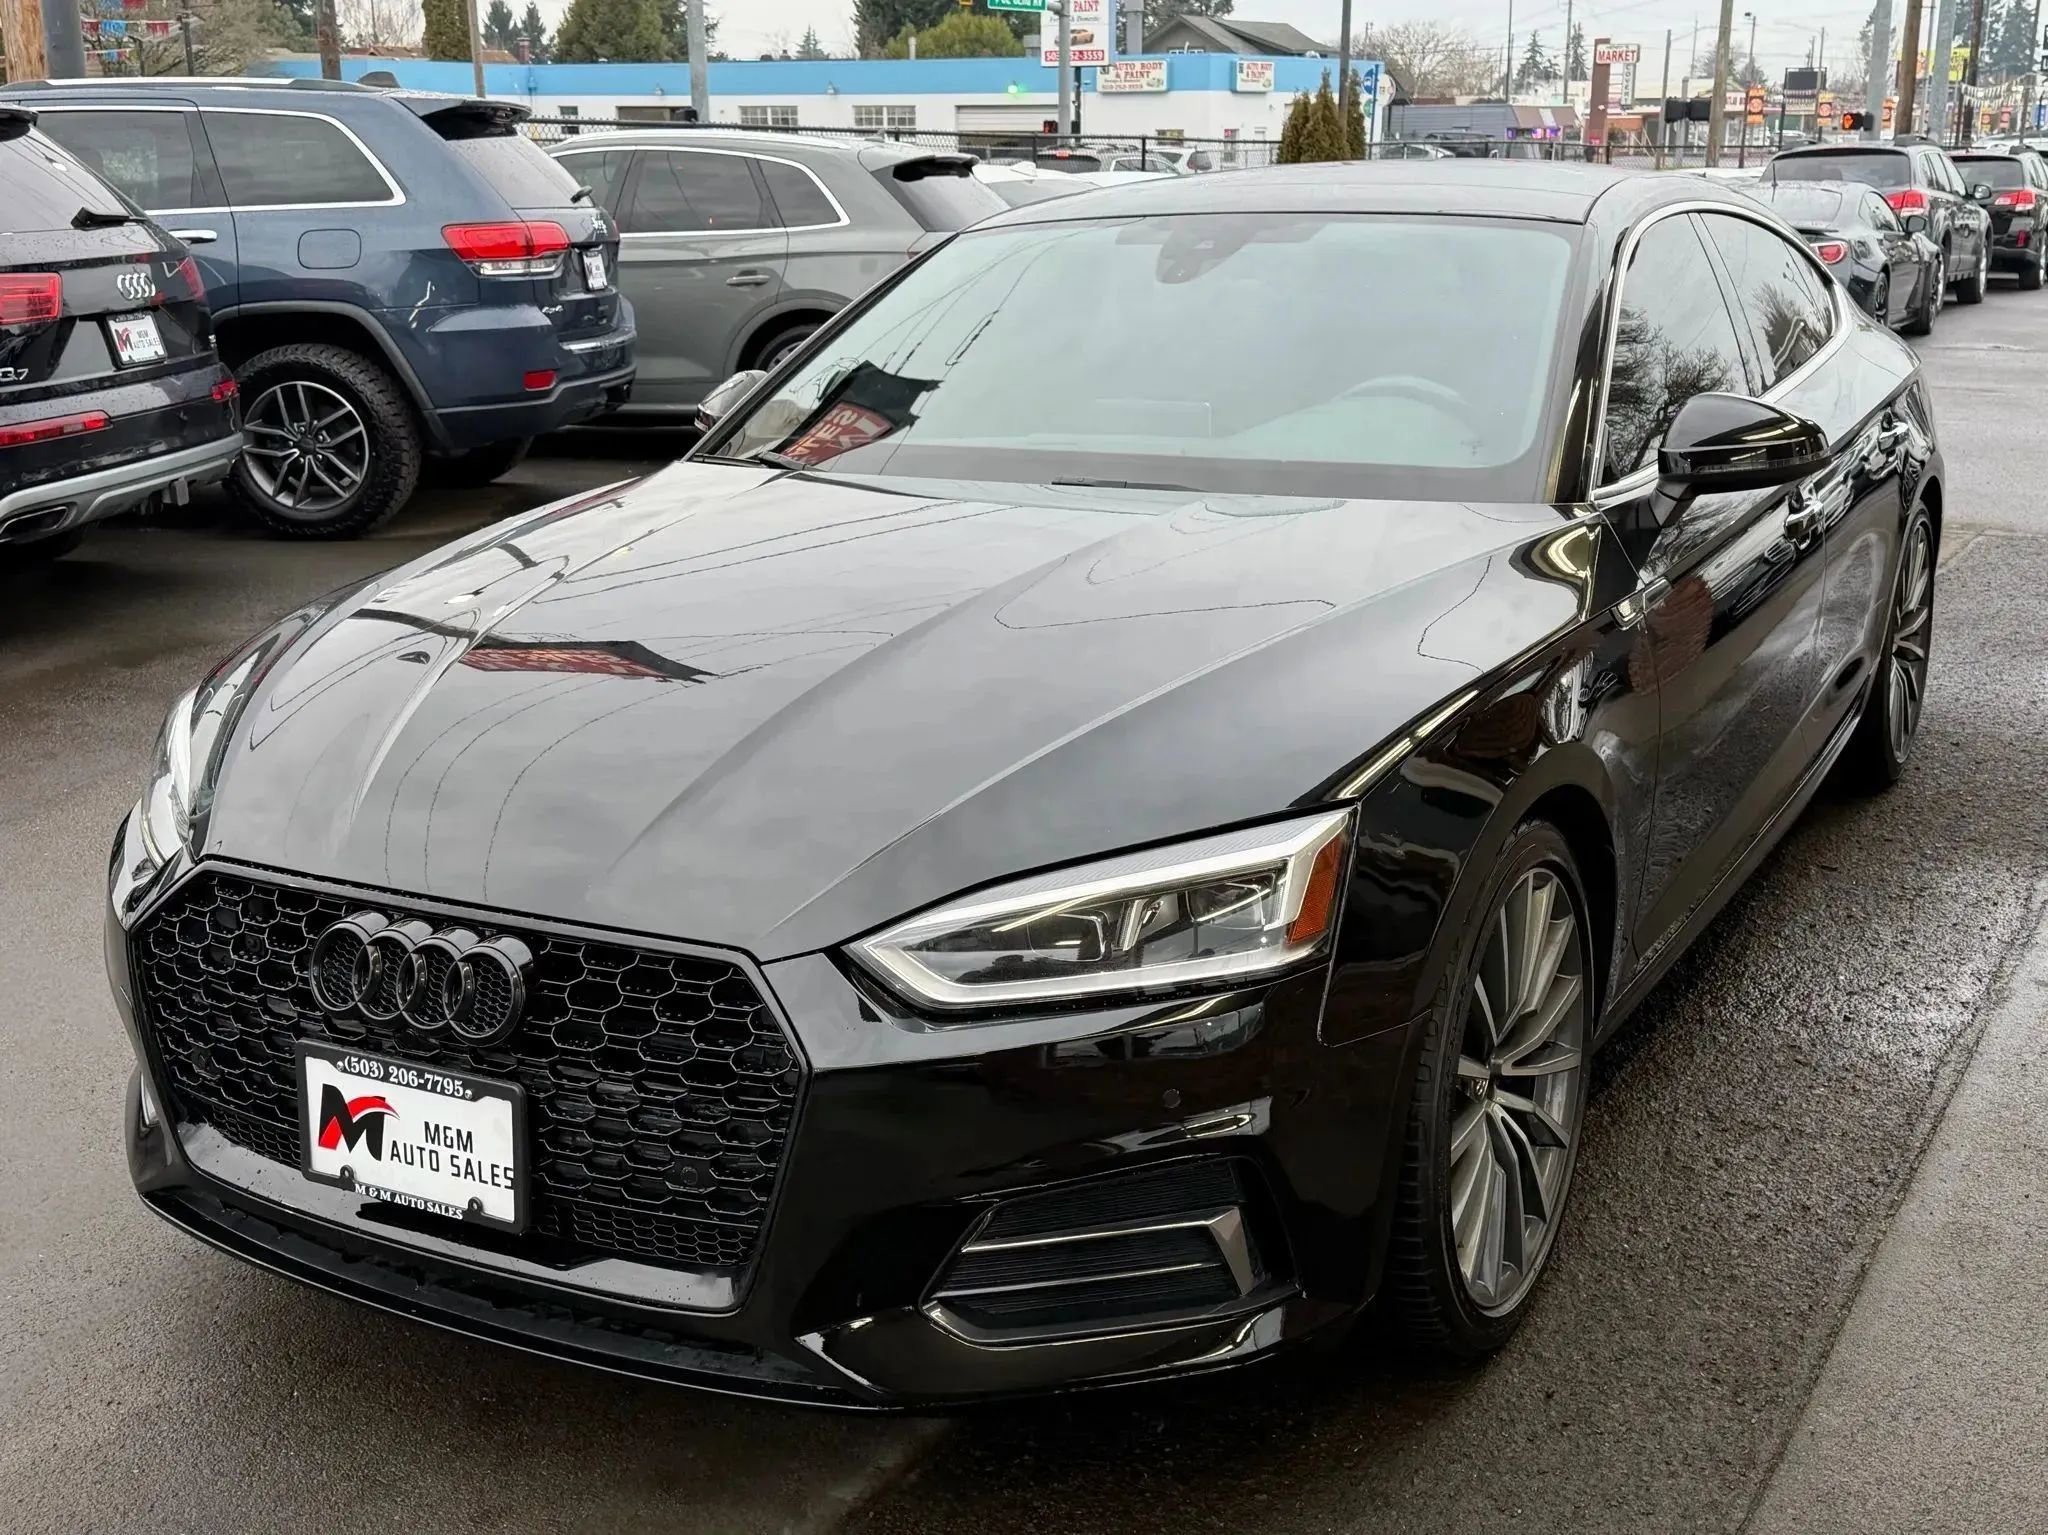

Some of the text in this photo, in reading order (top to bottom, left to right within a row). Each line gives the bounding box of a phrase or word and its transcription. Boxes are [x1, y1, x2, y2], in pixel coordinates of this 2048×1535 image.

[1115, 62, 1136, 71] AUTO
[1598, 50, 1637, 61] MARKET
[1124, 71, 1151, 79] PAINT
[344, 1054, 465, 1098] (503) 206-7795
[424, 1121, 474, 1154] M&M
[390, 1140, 515, 1191] AUTO SALES
[354, 1183, 464, 1221] M & M AUTO SALES
